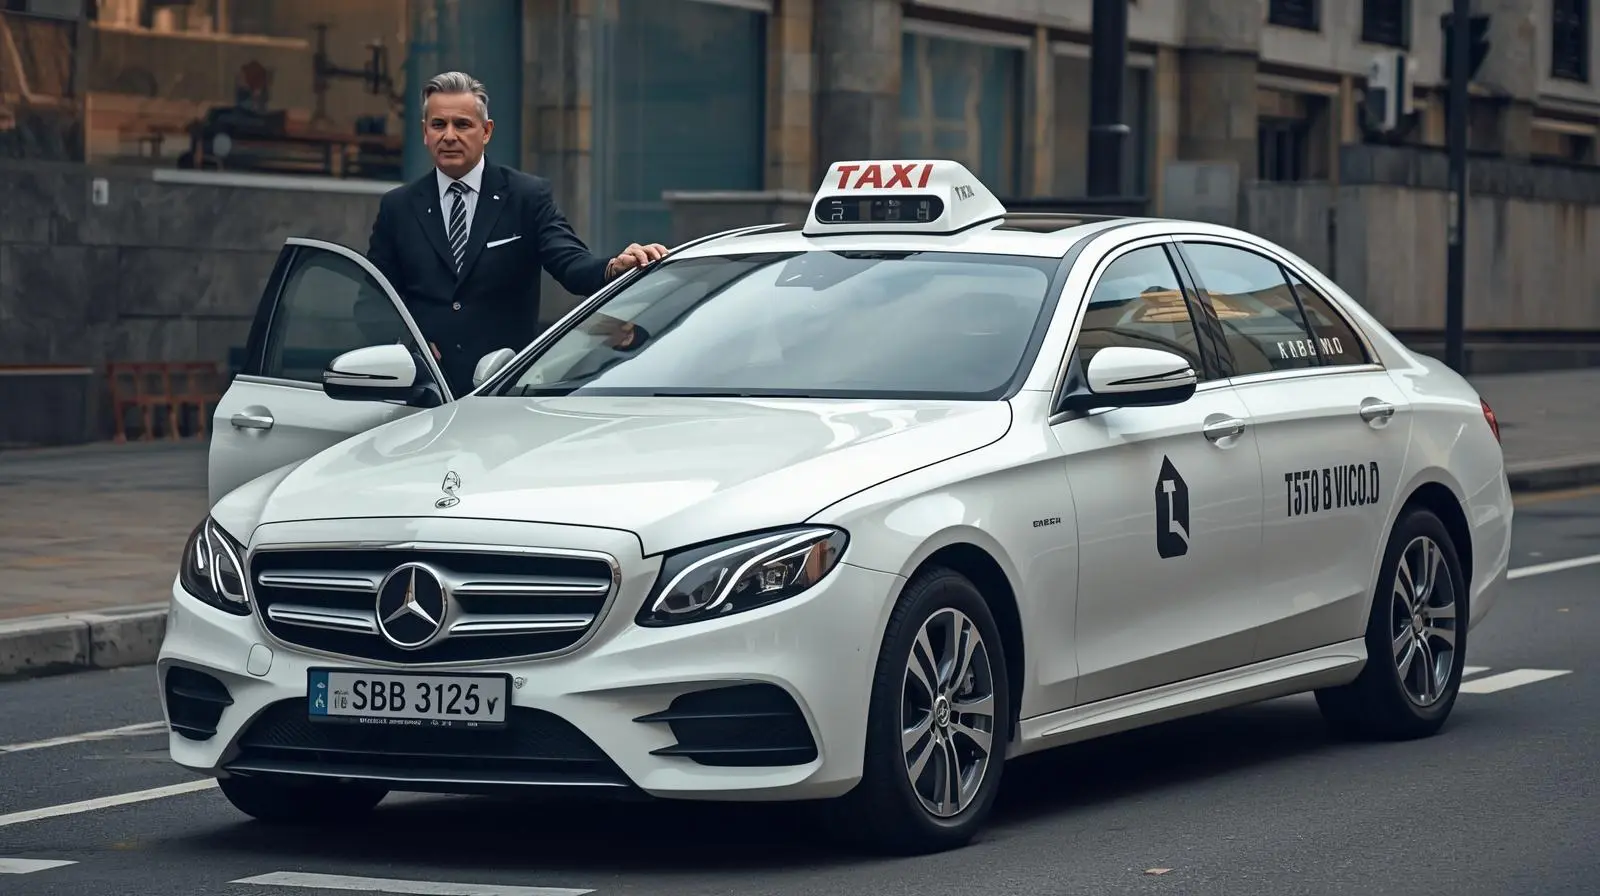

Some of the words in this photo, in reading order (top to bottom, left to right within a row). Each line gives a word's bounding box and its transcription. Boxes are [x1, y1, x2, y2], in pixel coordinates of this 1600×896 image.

[837, 163, 934, 190] TAXI
[352, 680, 406, 712] SBB
[414, 683, 480, 715] 3125
